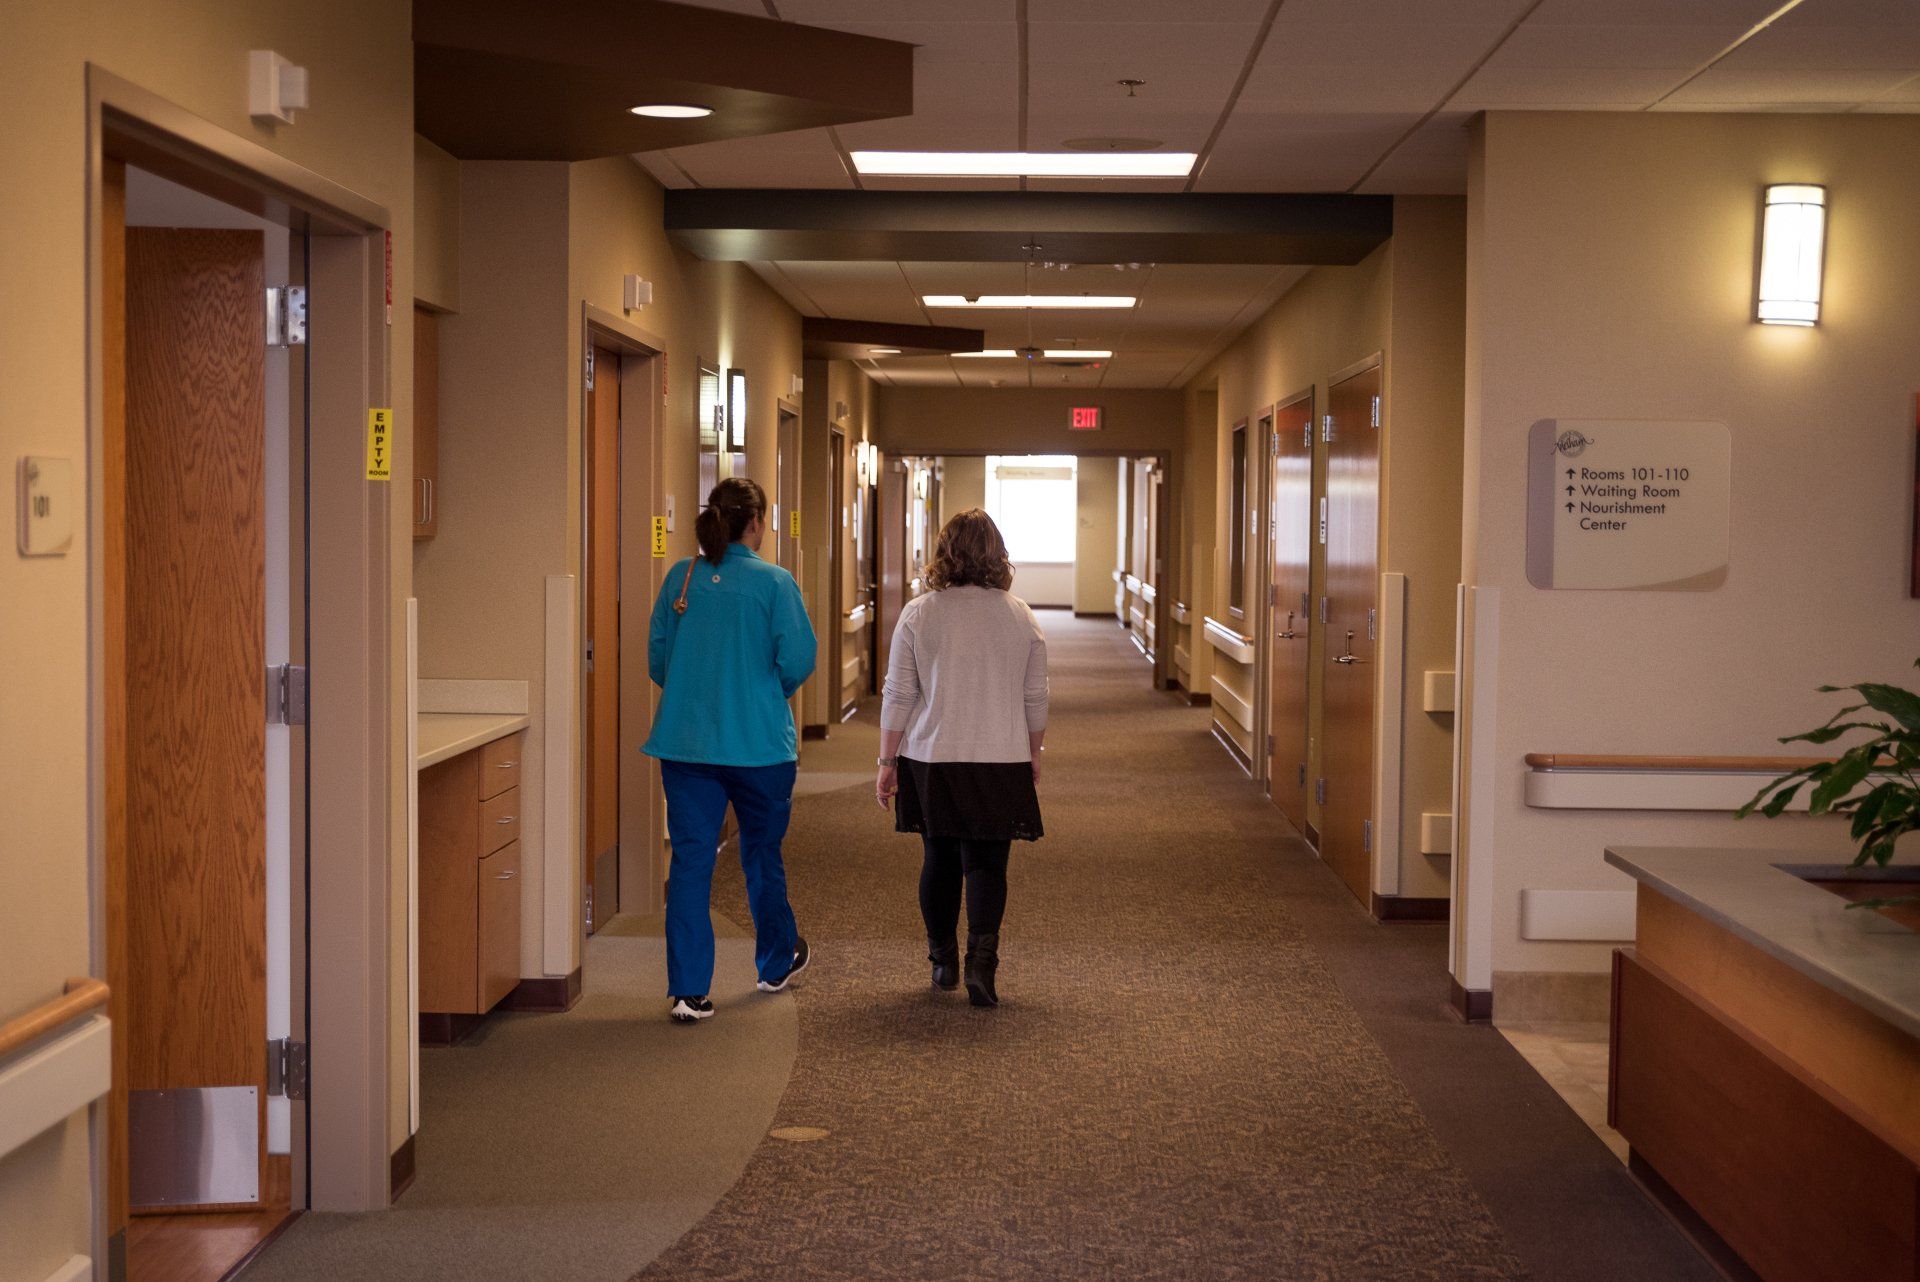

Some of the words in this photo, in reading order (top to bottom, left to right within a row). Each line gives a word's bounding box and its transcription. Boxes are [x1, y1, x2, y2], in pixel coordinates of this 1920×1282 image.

[1073, 407, 1098, 428] EXIT
[374, 412, 385, 469] EMPTY
[1581, 467, 1625, 481] Rooms
[1631, 467, 1690, 481] 101-110
[1580, 484, 1637, 501] Waiting
[1642, 484, 1681, 498] Room
[1580, 501, 1666, 514] Nourishment
[1579, 517, 1627, 531] Center
[655, 518, 663, 551] EMPTY
